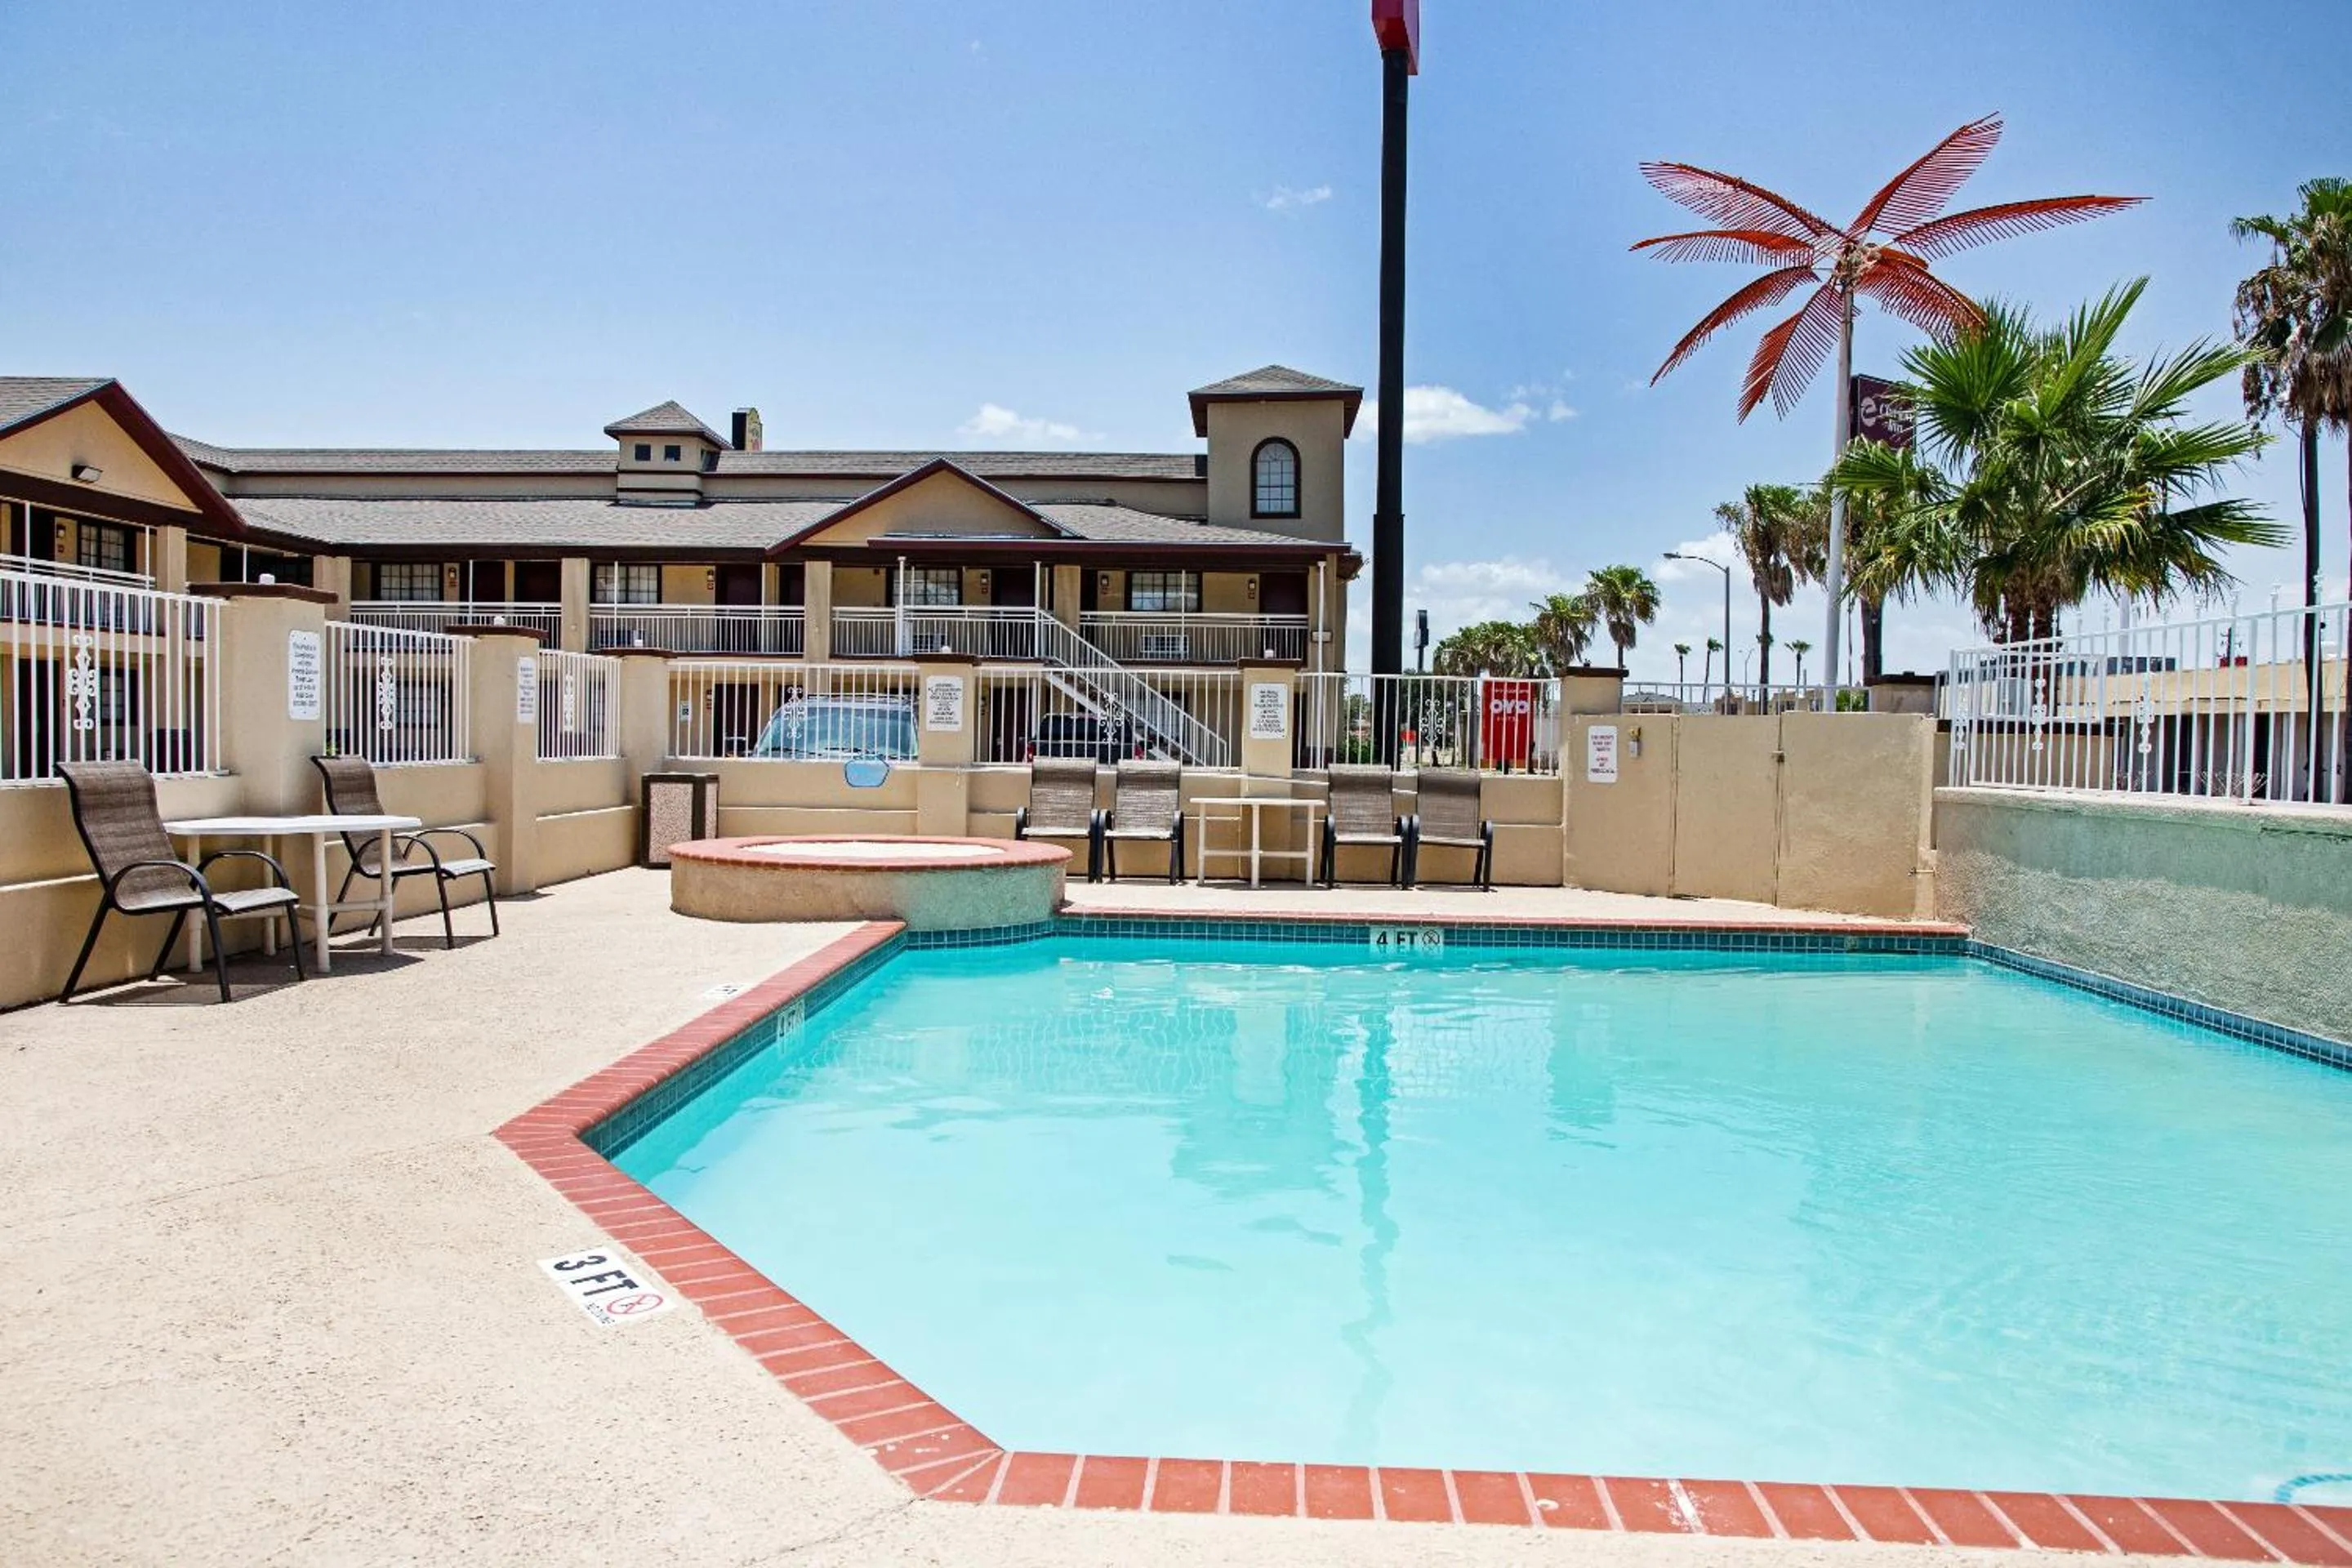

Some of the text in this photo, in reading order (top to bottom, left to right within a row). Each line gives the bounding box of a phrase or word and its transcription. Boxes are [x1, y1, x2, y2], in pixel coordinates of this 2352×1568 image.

[1490, 699, 1530, 714] OYO
[1376, 931, 1418, 945] 4 FT
[554, 1255, 639, 1296] 3 FT
